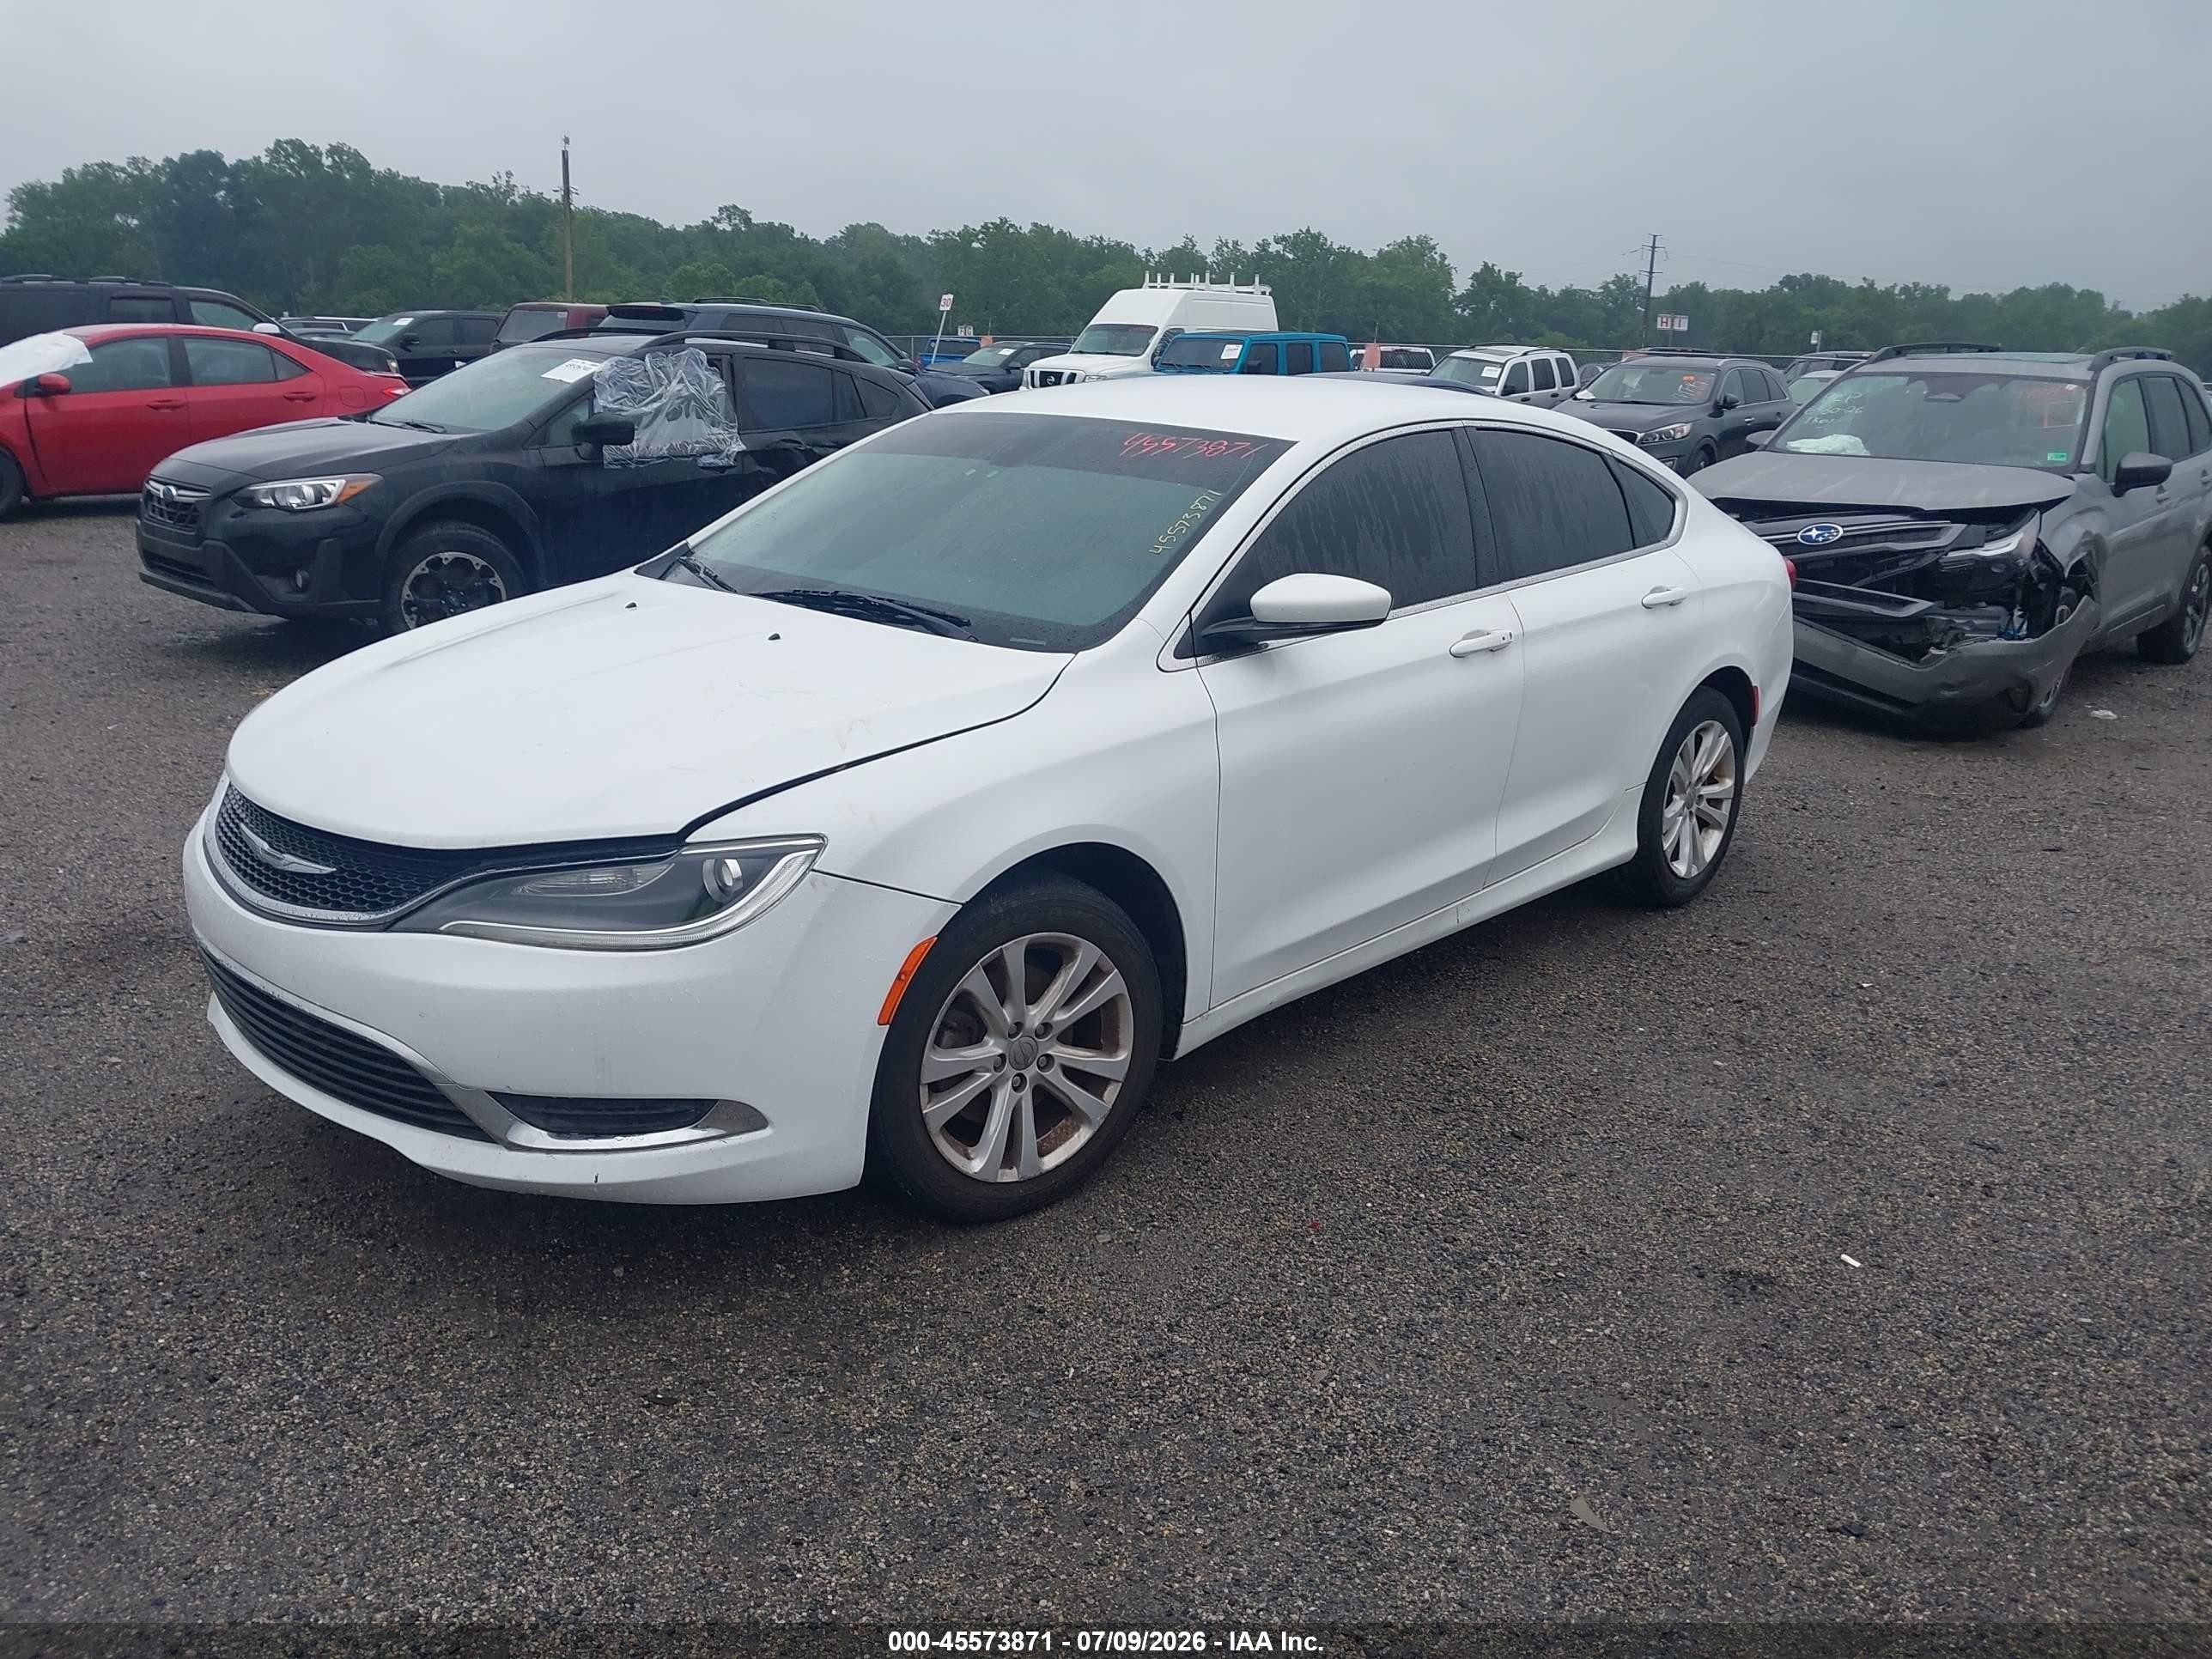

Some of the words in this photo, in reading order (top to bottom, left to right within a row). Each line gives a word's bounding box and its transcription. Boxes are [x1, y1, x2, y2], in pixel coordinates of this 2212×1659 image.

[941, 298, 951, 307] 30
[1660, 316, 1668, 327] H
[1119, 432, 1269, 459] 45573871
[1148, 489, 1224, 555] 45573871
